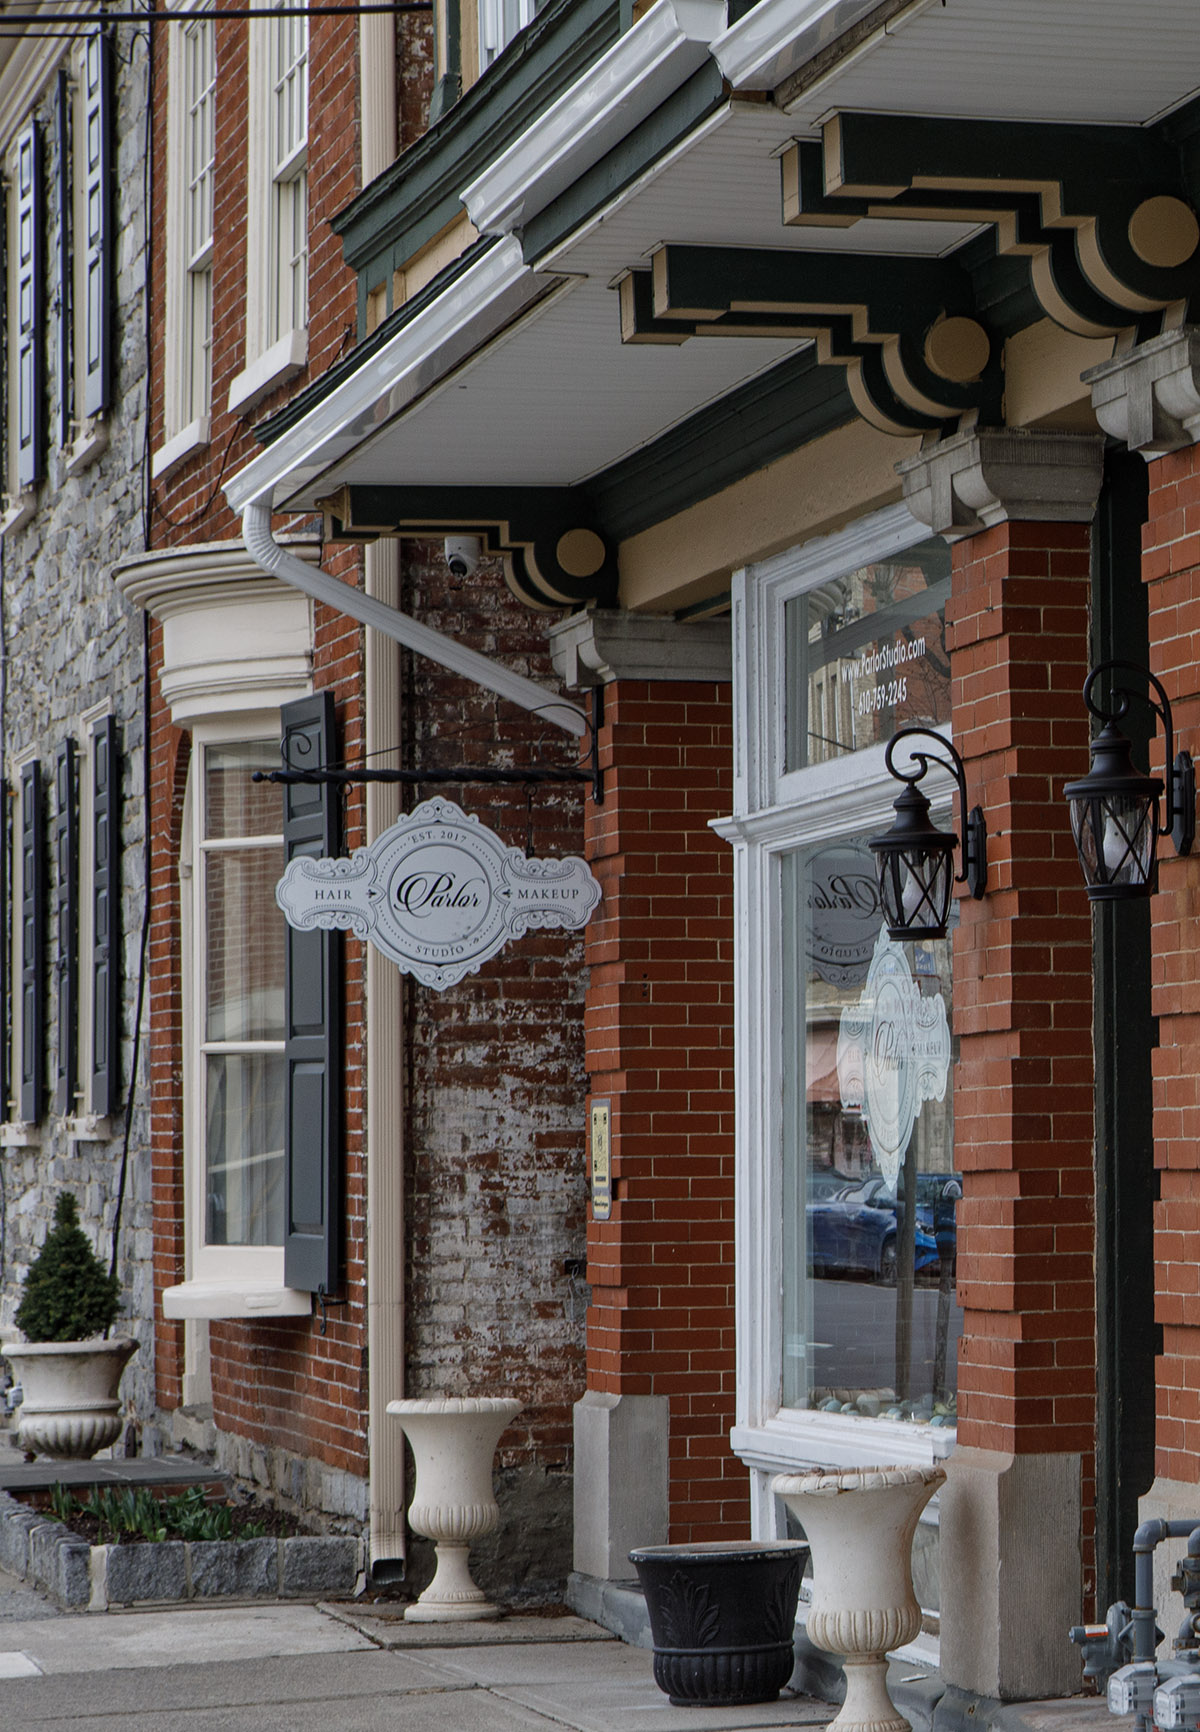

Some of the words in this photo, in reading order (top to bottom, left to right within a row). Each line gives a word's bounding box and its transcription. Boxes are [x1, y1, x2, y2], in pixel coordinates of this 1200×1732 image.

[841, 637, 926, 684] www.ParlorStudio.com
[858, 677, 907, 716] 610-759-2245
[440, 830, 467, 843] 2017
[314, 889, 352, 900] HAIR
[394, 872, 485, 918] Parlor
[518, 888, 579, 900] MAKEUP
[415, 944, 464, 957] STUDIO
